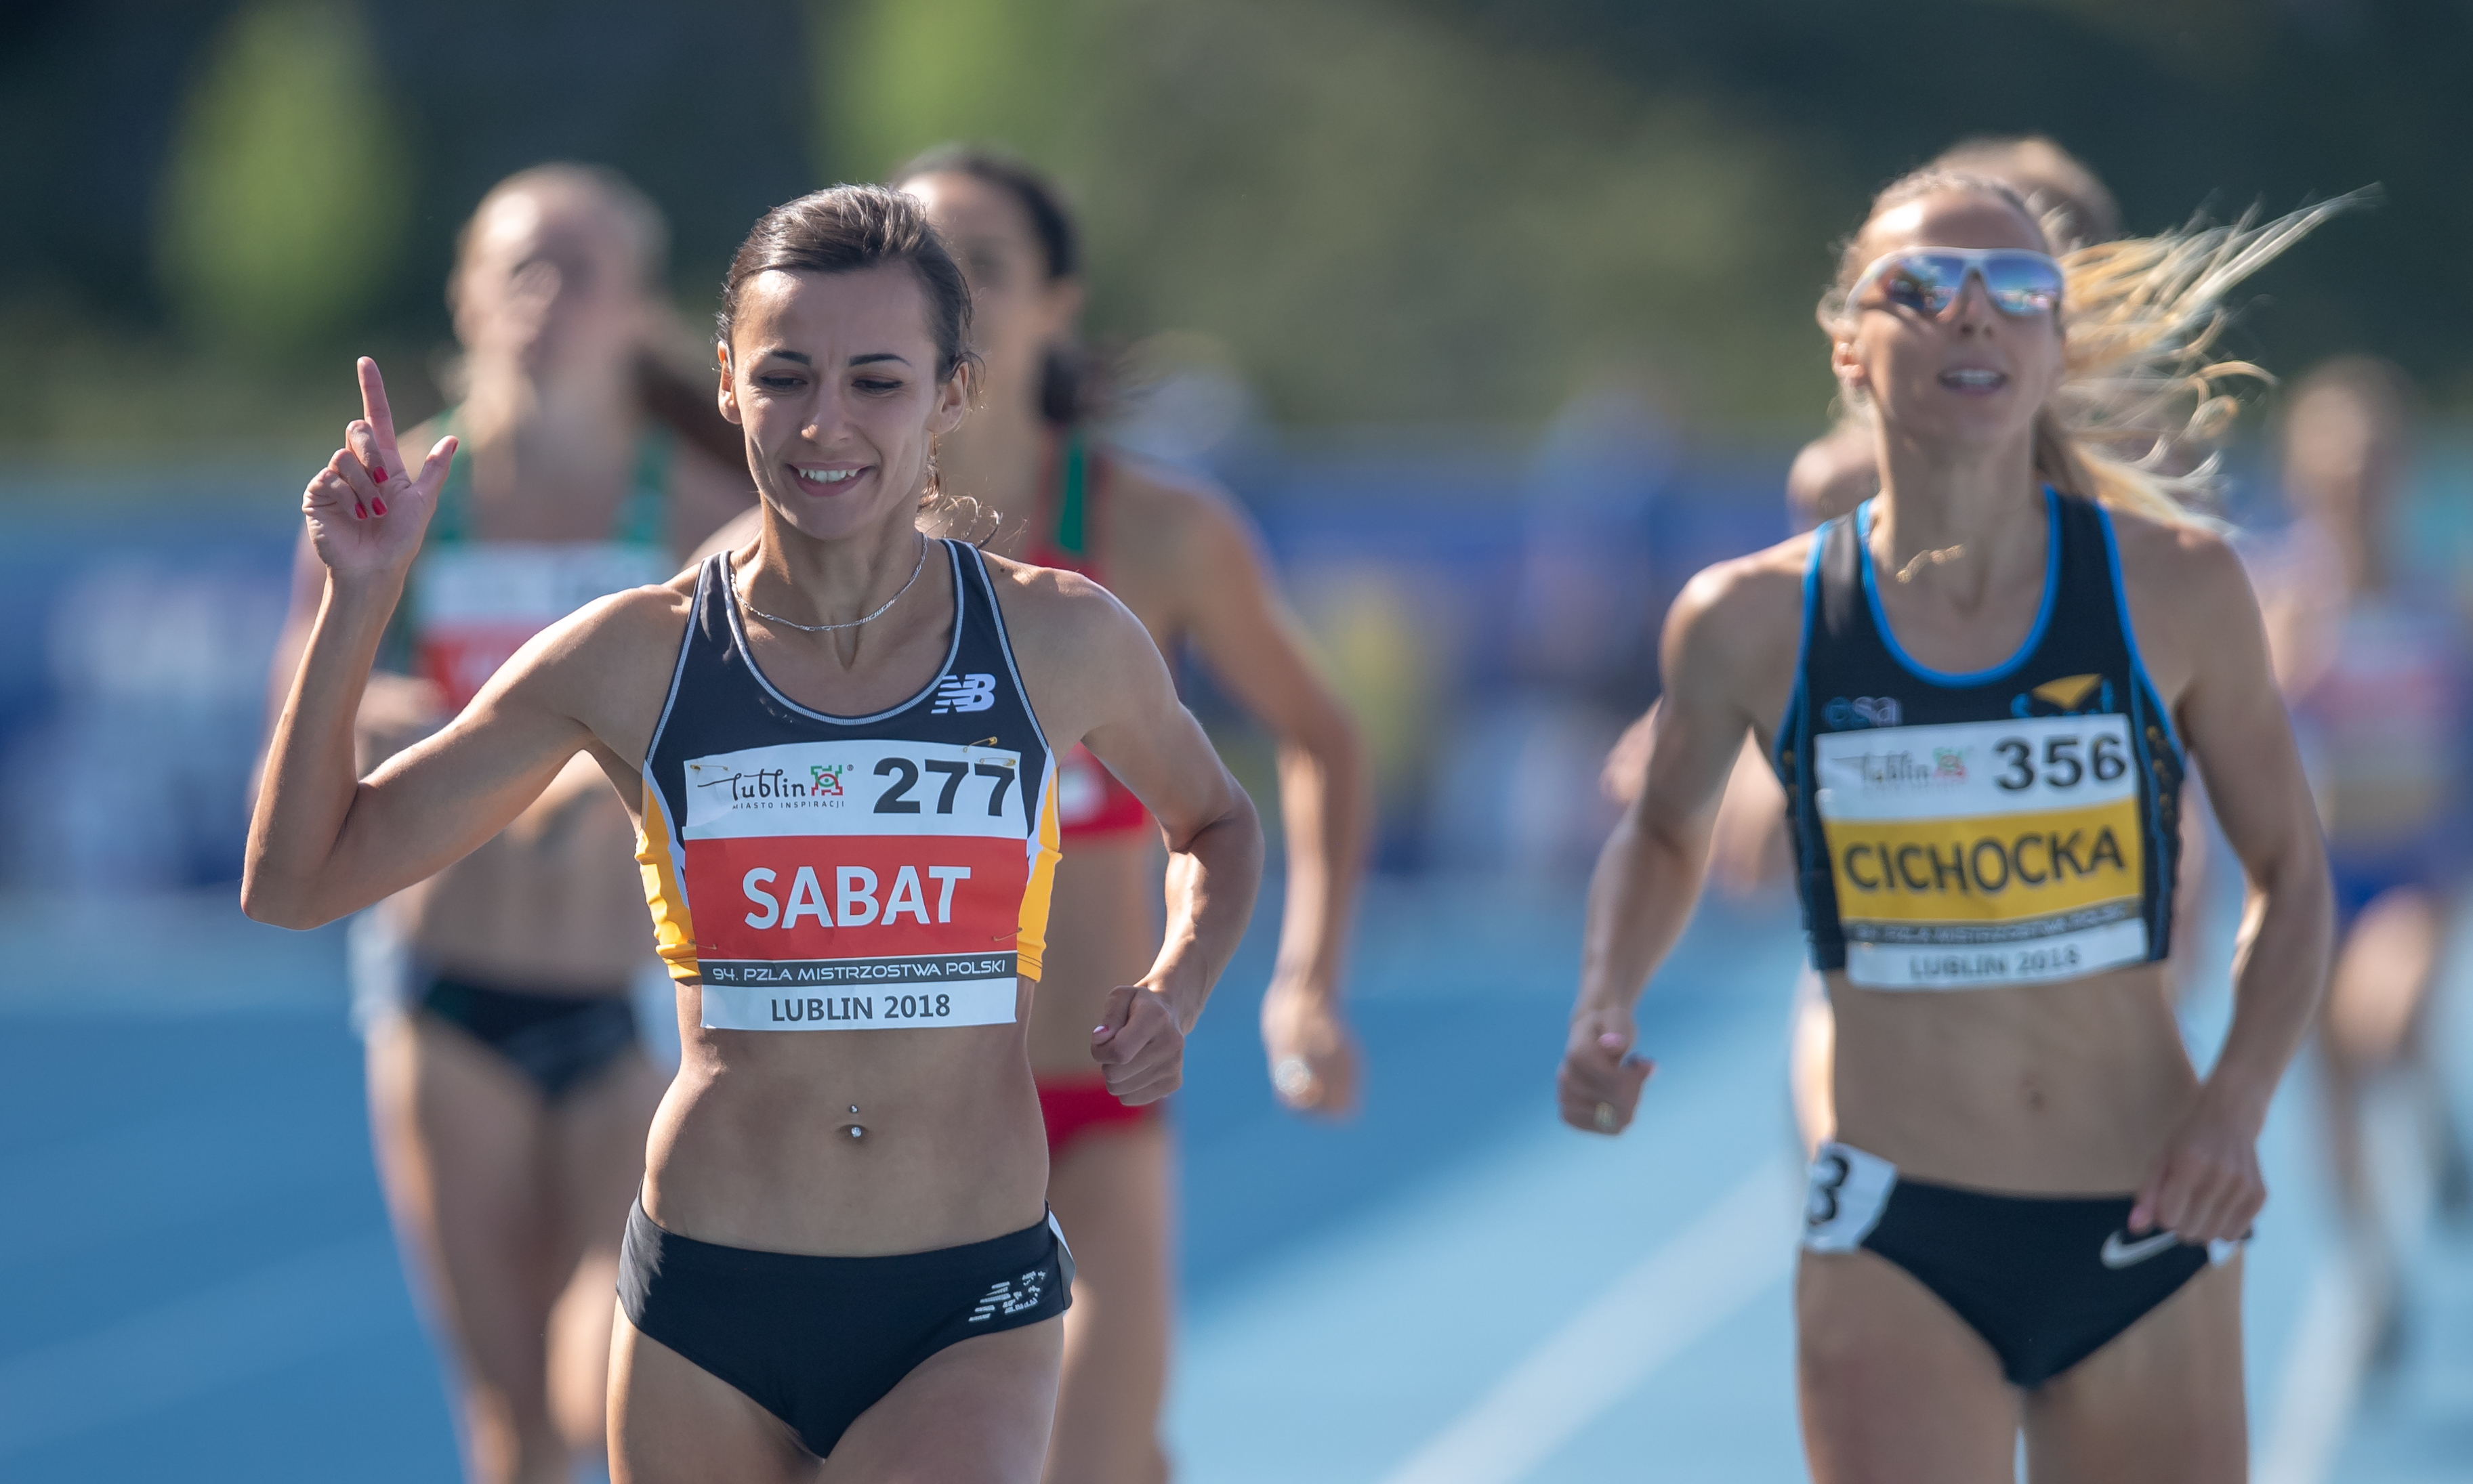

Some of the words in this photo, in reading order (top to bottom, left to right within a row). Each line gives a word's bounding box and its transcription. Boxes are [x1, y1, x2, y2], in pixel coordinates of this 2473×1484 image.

[931, 673, 996, 715] NB
[1993, 733, 2127, 791] 356
[698, 769, 806, 801] lublin
[781, 800, 845, 809] INSPIRACJI
[873, 757, 1016, 817] 277
[1843, 825, 2126, 894] CICHOCKA
[743, 866, 972, 929] SABAT
[712, 968, 739, 981] 94.
[744, 967, 793, 981] PZLA
[797, 962, 942, 981] MISTRZOSTWA
[946, 959, 1005, 975] POLSKI
[1909, 954, 2008, 980] LUBLIN
[2015, 943, 2082, 974] 2018
[771, 996, 873, 1022] LUBLIN
[884, 994, 951, 1018] 2018
